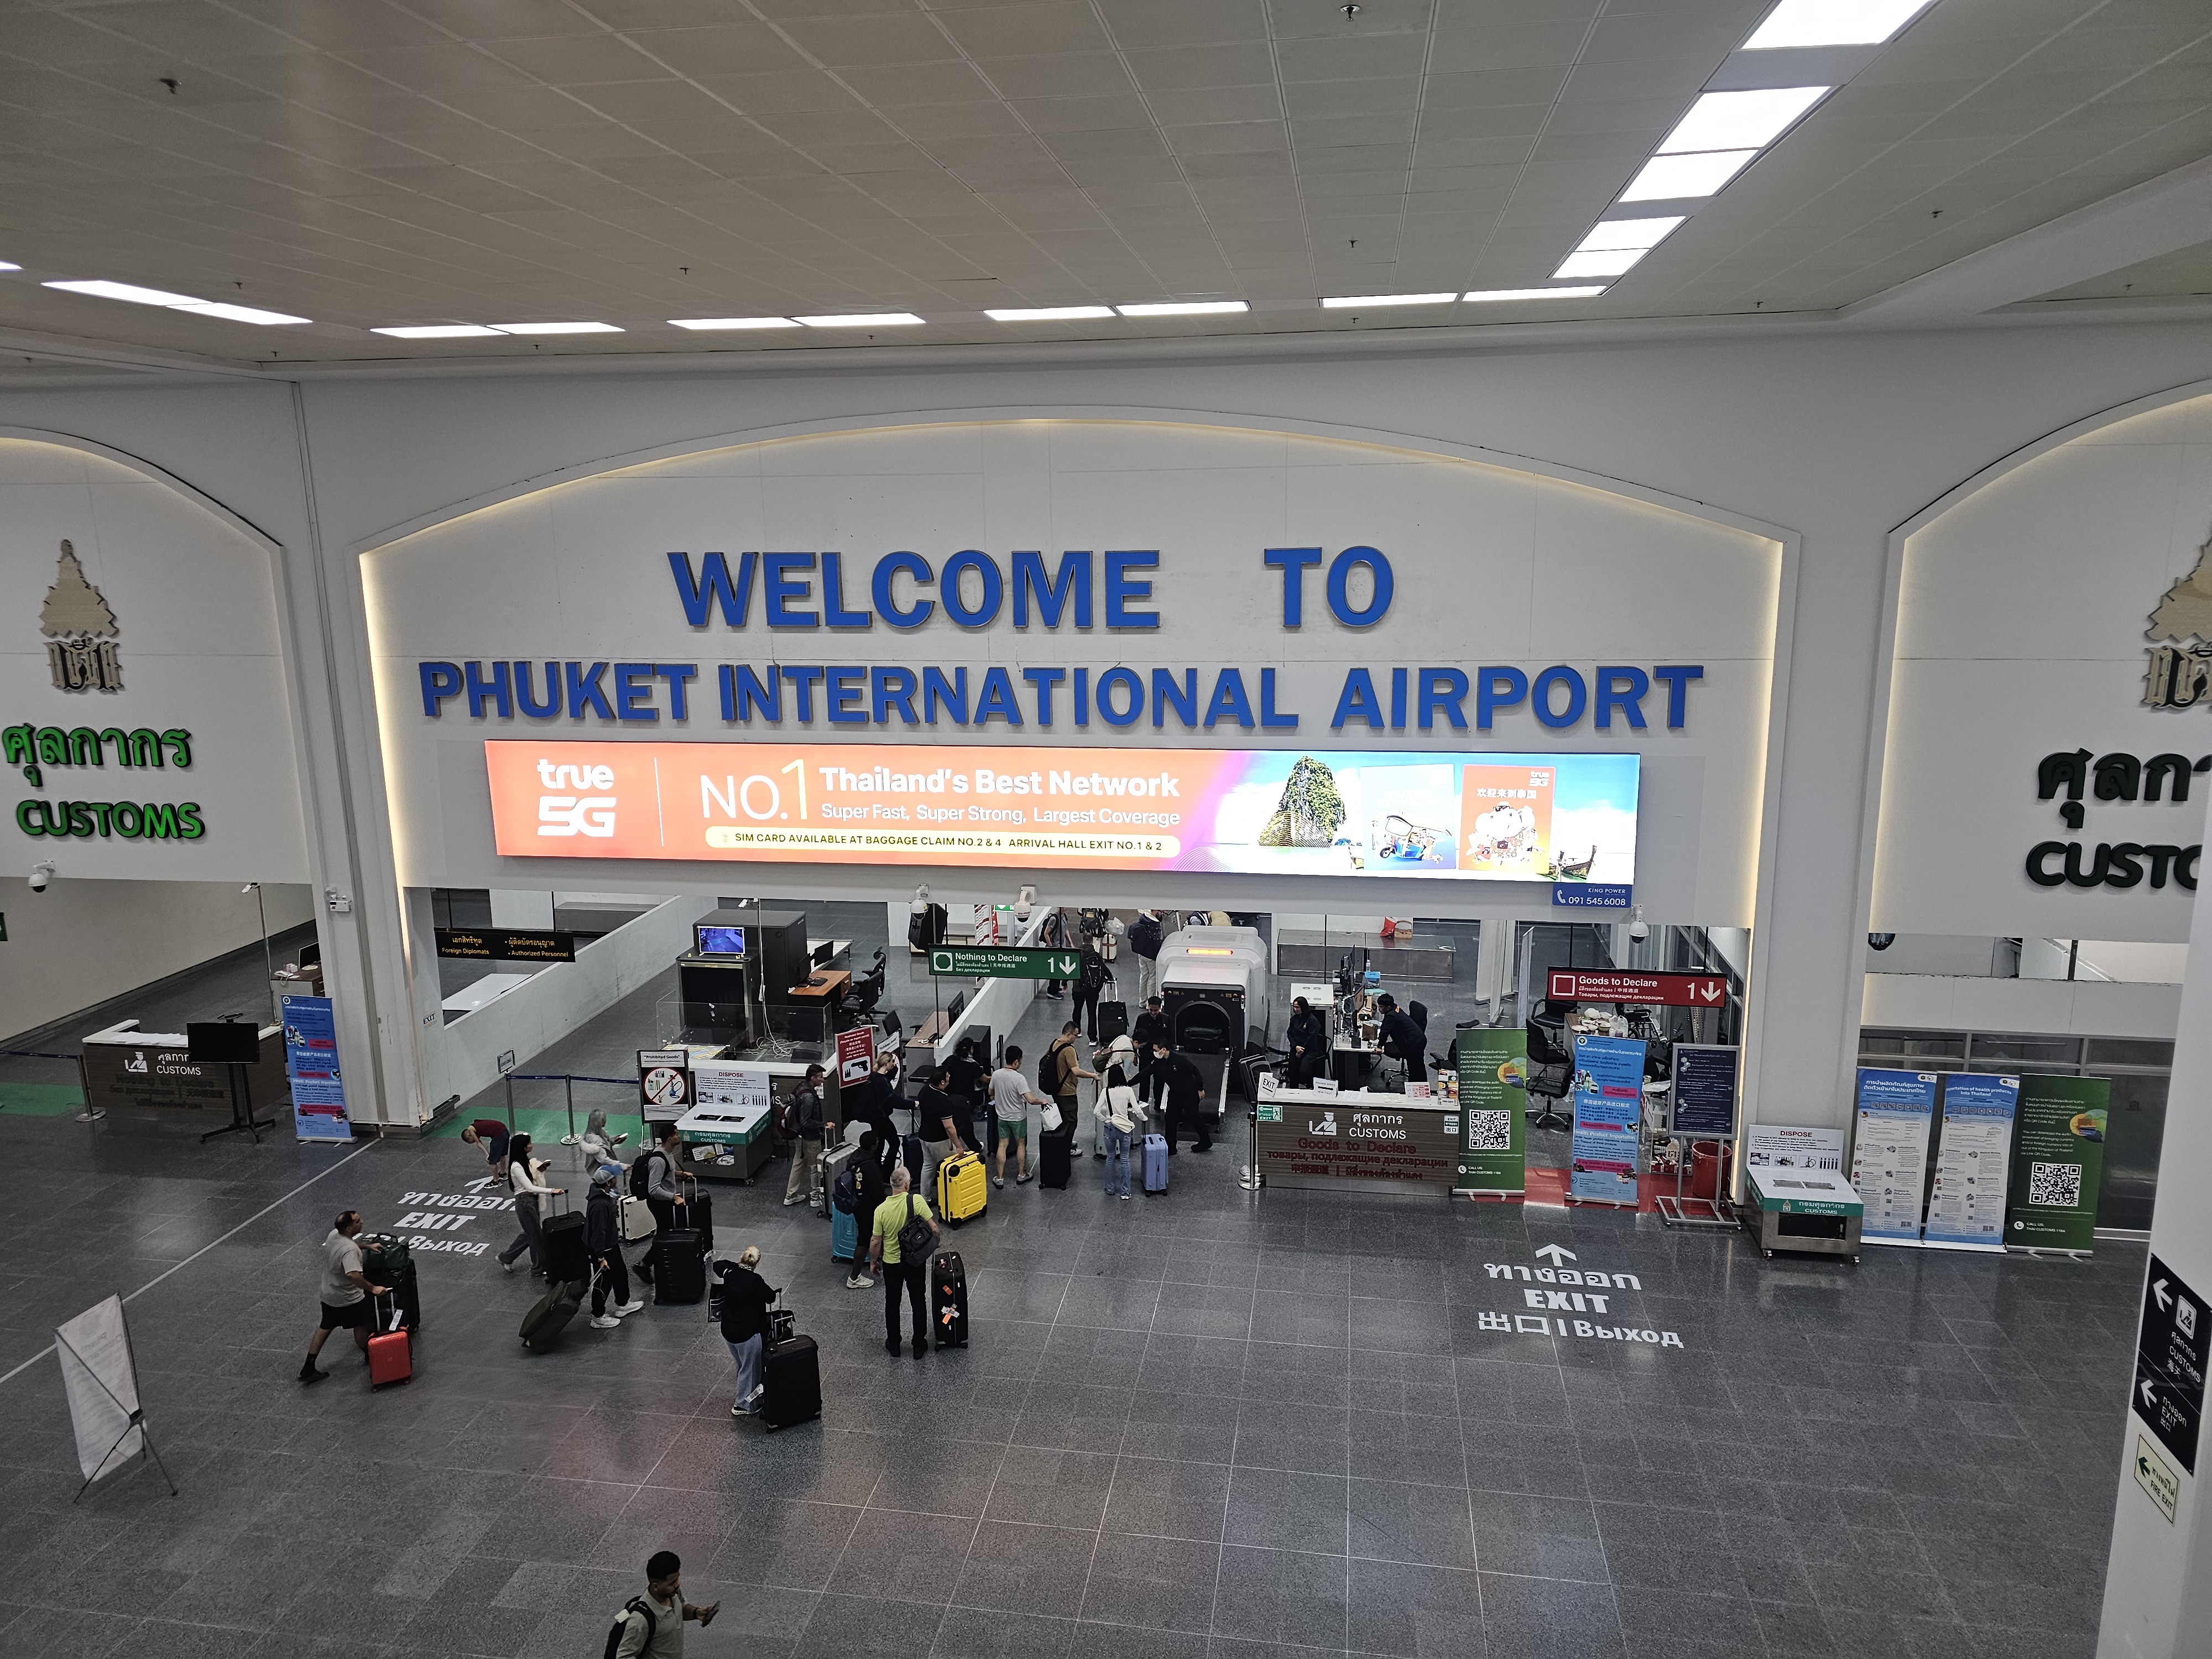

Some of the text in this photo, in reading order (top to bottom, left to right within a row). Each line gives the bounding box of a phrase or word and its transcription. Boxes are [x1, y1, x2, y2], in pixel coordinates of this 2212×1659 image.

[666, 545, 1394, 628] WELCOME TO
[419, 661, 1704, 729] PHUKET INTERNATIONAL AIRPORT
[2, 723, 191, 787] ศุลกากร
[537, 759, 614, 789] true
[818, 766, 1180, 797] Thailand's Best Network
[1529, 778, 1550, 786] 5G
[1477, 788, 1537, 800] 欢迎来到泰国
[2038, 747, 2212, 829] ศุลก
[17, 799, 205, 839] CUSTOMS
[537, 796, 617, 837] 5G
[821, 804, 1180, 827] Super Fast, Super Strong, Largest Coverage
[735, 833, 1001, 847] SIM CARD AVAILABLE AT BAGGAGE CLAIM NO.2 & 4
[1009, 838, 1162, 850] ARRIVAL HALL EXIT NO.1 & 2
[955, 952, 985, 962] Nothing
[1047, 957, 1054, 973] 1
[1579, 976, 1609, 985] Goods
[1623, 978, 1658, 987] Declare
[1687, 983, 1695, 999] 1
[423, 1013, 435, 1024] EXIT
[156, 1066, 201, 1076] CUSTOMS
[1262, 1078, 1275, 1089] EXIT
[1353, 1113, 1404, 1126] ศุลกากร
[1349, 1128, 1406, 1140] CUSTOMS
[1298, 1138, 1417, 1154] Goods to Declare
[1311, 1153, 1380, 1165] подлежащие
[1383, 1156, 1448, 1168] декларации
[393, 1212, 477, 1230] EXIT
[408, 1235, 491, 1256] Выход
[1483, 1262, 1642, 1290] ทางออก
[1524, 1289, 1609, 1313] EXIT
[1478, 1311, 1550, 1335] 出口
[1573, 1319, 1684, 1349] Выход
[2172, 1331, 2197, 1361] ศุลกากร
[2167, 1358, 2181, 1380] 海关
[2169, 1345, 2201, 1383] CUSTOMS
[2162, 1406, 2177, 1427] EXIT
[2163, 1396, 2187, 1427] ทางออก
[2160, 1416, 2171, 1433] 出口
[2151, 1479, 2173, 1511] FIRE EXIT
